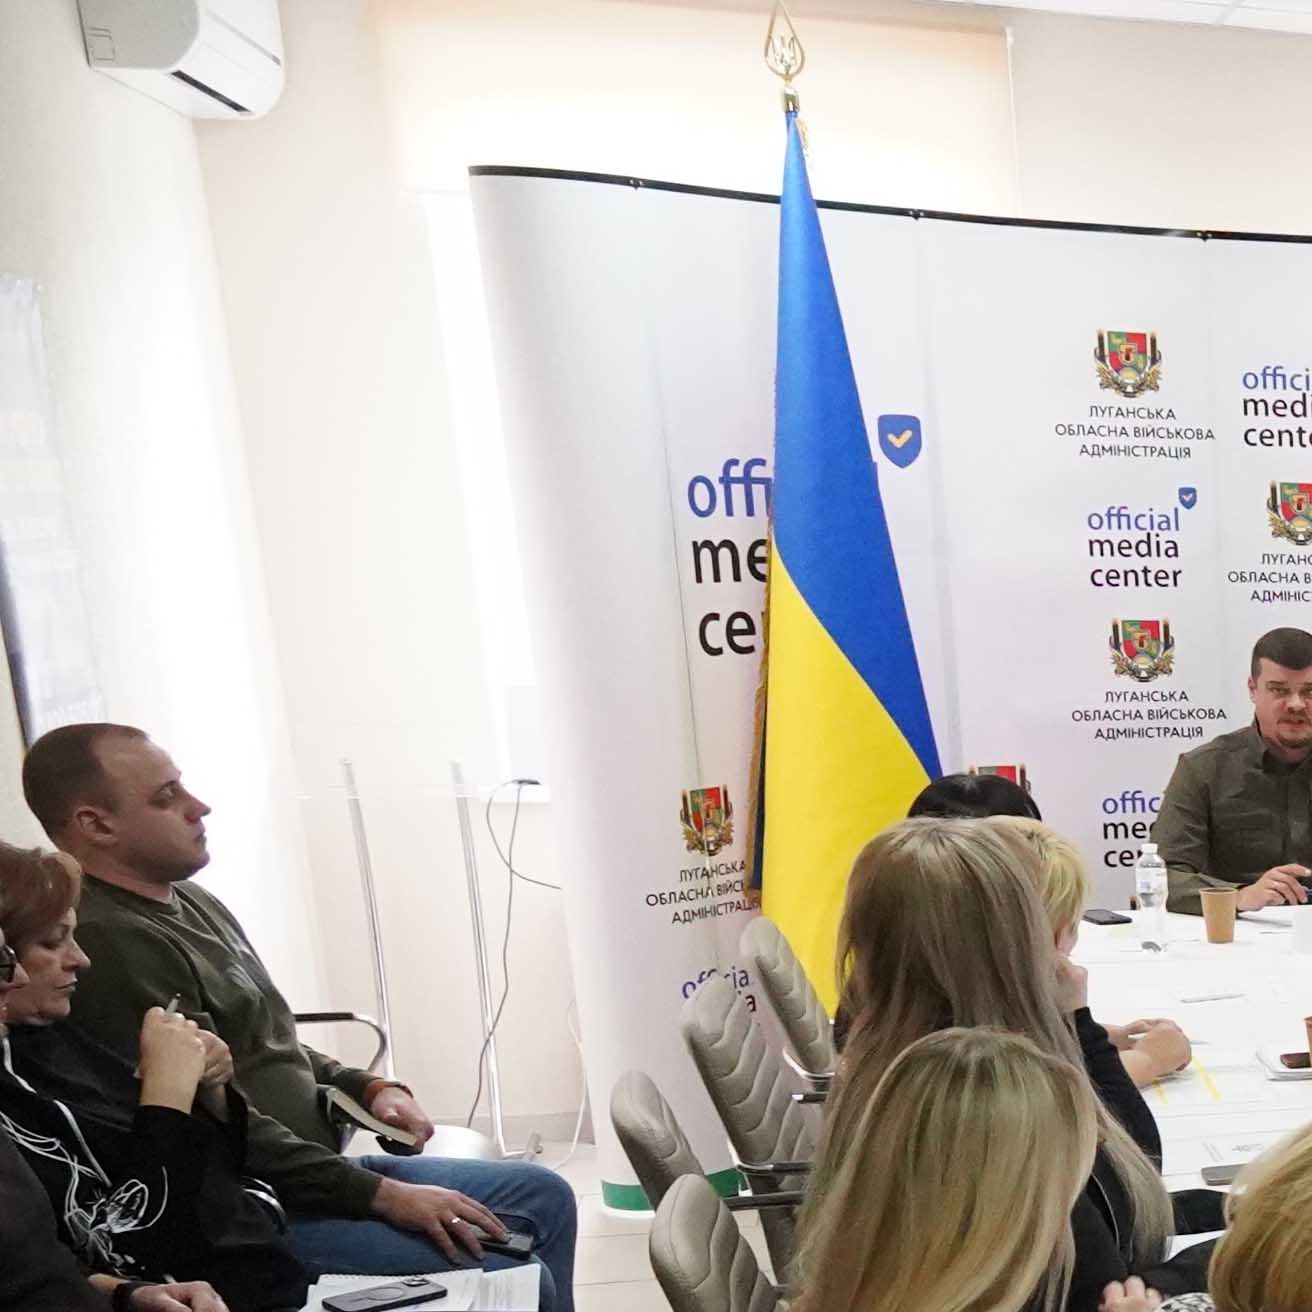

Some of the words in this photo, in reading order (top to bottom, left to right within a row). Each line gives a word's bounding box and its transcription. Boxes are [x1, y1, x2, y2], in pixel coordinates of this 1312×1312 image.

[1089, 404, 1176, 421] ЛУГАНСЬКА
[1055, 423, 1130, 439] ОБЛАСНА
[1133, 425, 1215, 441] ВІЙСЬКОВА
[1079, 443, 1192, 461] АДМІНІСТРАЦІЯ
[687, 457, 772, 519] offi
[1087, 506, 1180, 532] official
[1088, 532, 1179, 559] media
[1090, 566, 1183, 588] center
[1227, 570, 1300, 585] ОБЛАСНА
[1104, 691, 1190, 704] ЛУГАНСЬКА
[1072, 710, 1143, 723] ОБЛАСНА
[1147, 707, 1227, 722] ВІЙСЬКОВА
[1094, 726, 1204, 740] АДМІНІСТРАЦІЯ
[1102, 790, 1161, 815] offic
[646, 887, 714, 907] ОБЛАСНА
